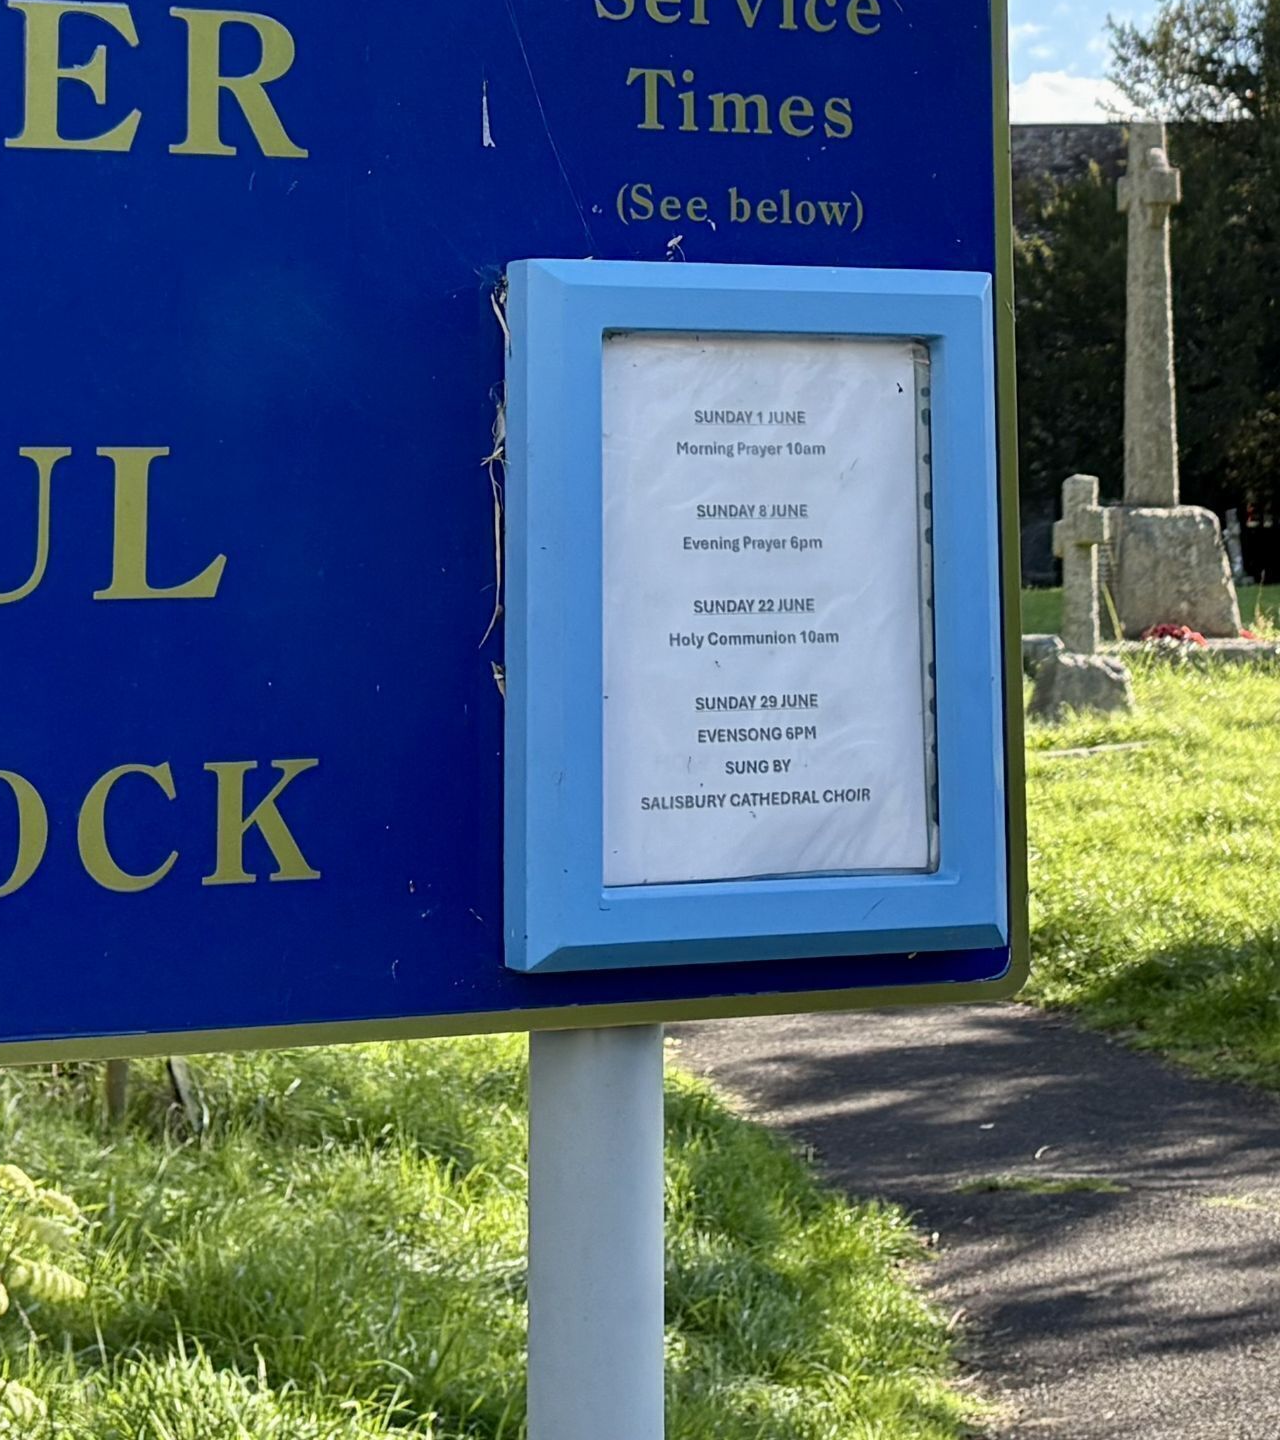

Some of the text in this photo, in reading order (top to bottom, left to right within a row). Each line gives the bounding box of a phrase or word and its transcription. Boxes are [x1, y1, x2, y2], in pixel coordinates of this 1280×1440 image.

[626, 67, 854, 139] Times
[616, 182, 864, 233] (See below)
[694, 410, 806, 424] SUNDAY 1 JUNE
[676, 441, 826, 458] Morning Prayer 10am
[696, 504, 808, 518] SUNDAY 8 JUNE
[683, 536, 823, 552] Evening Prayer 6pm
[693, 598, 815, 613] SUNDAY 22 JUNE
[669, 630, 839, 649] Holy Communion 10am
[695, 694, 818, 711] SUNDAY 29 JUNE
[698, 726, 817, 743] EVENSONG 6PM
[725, 759, 791, 775] SUNG BY
[641, 788, 871, 810] SALISBURY CATHEDRAL CHOIR
